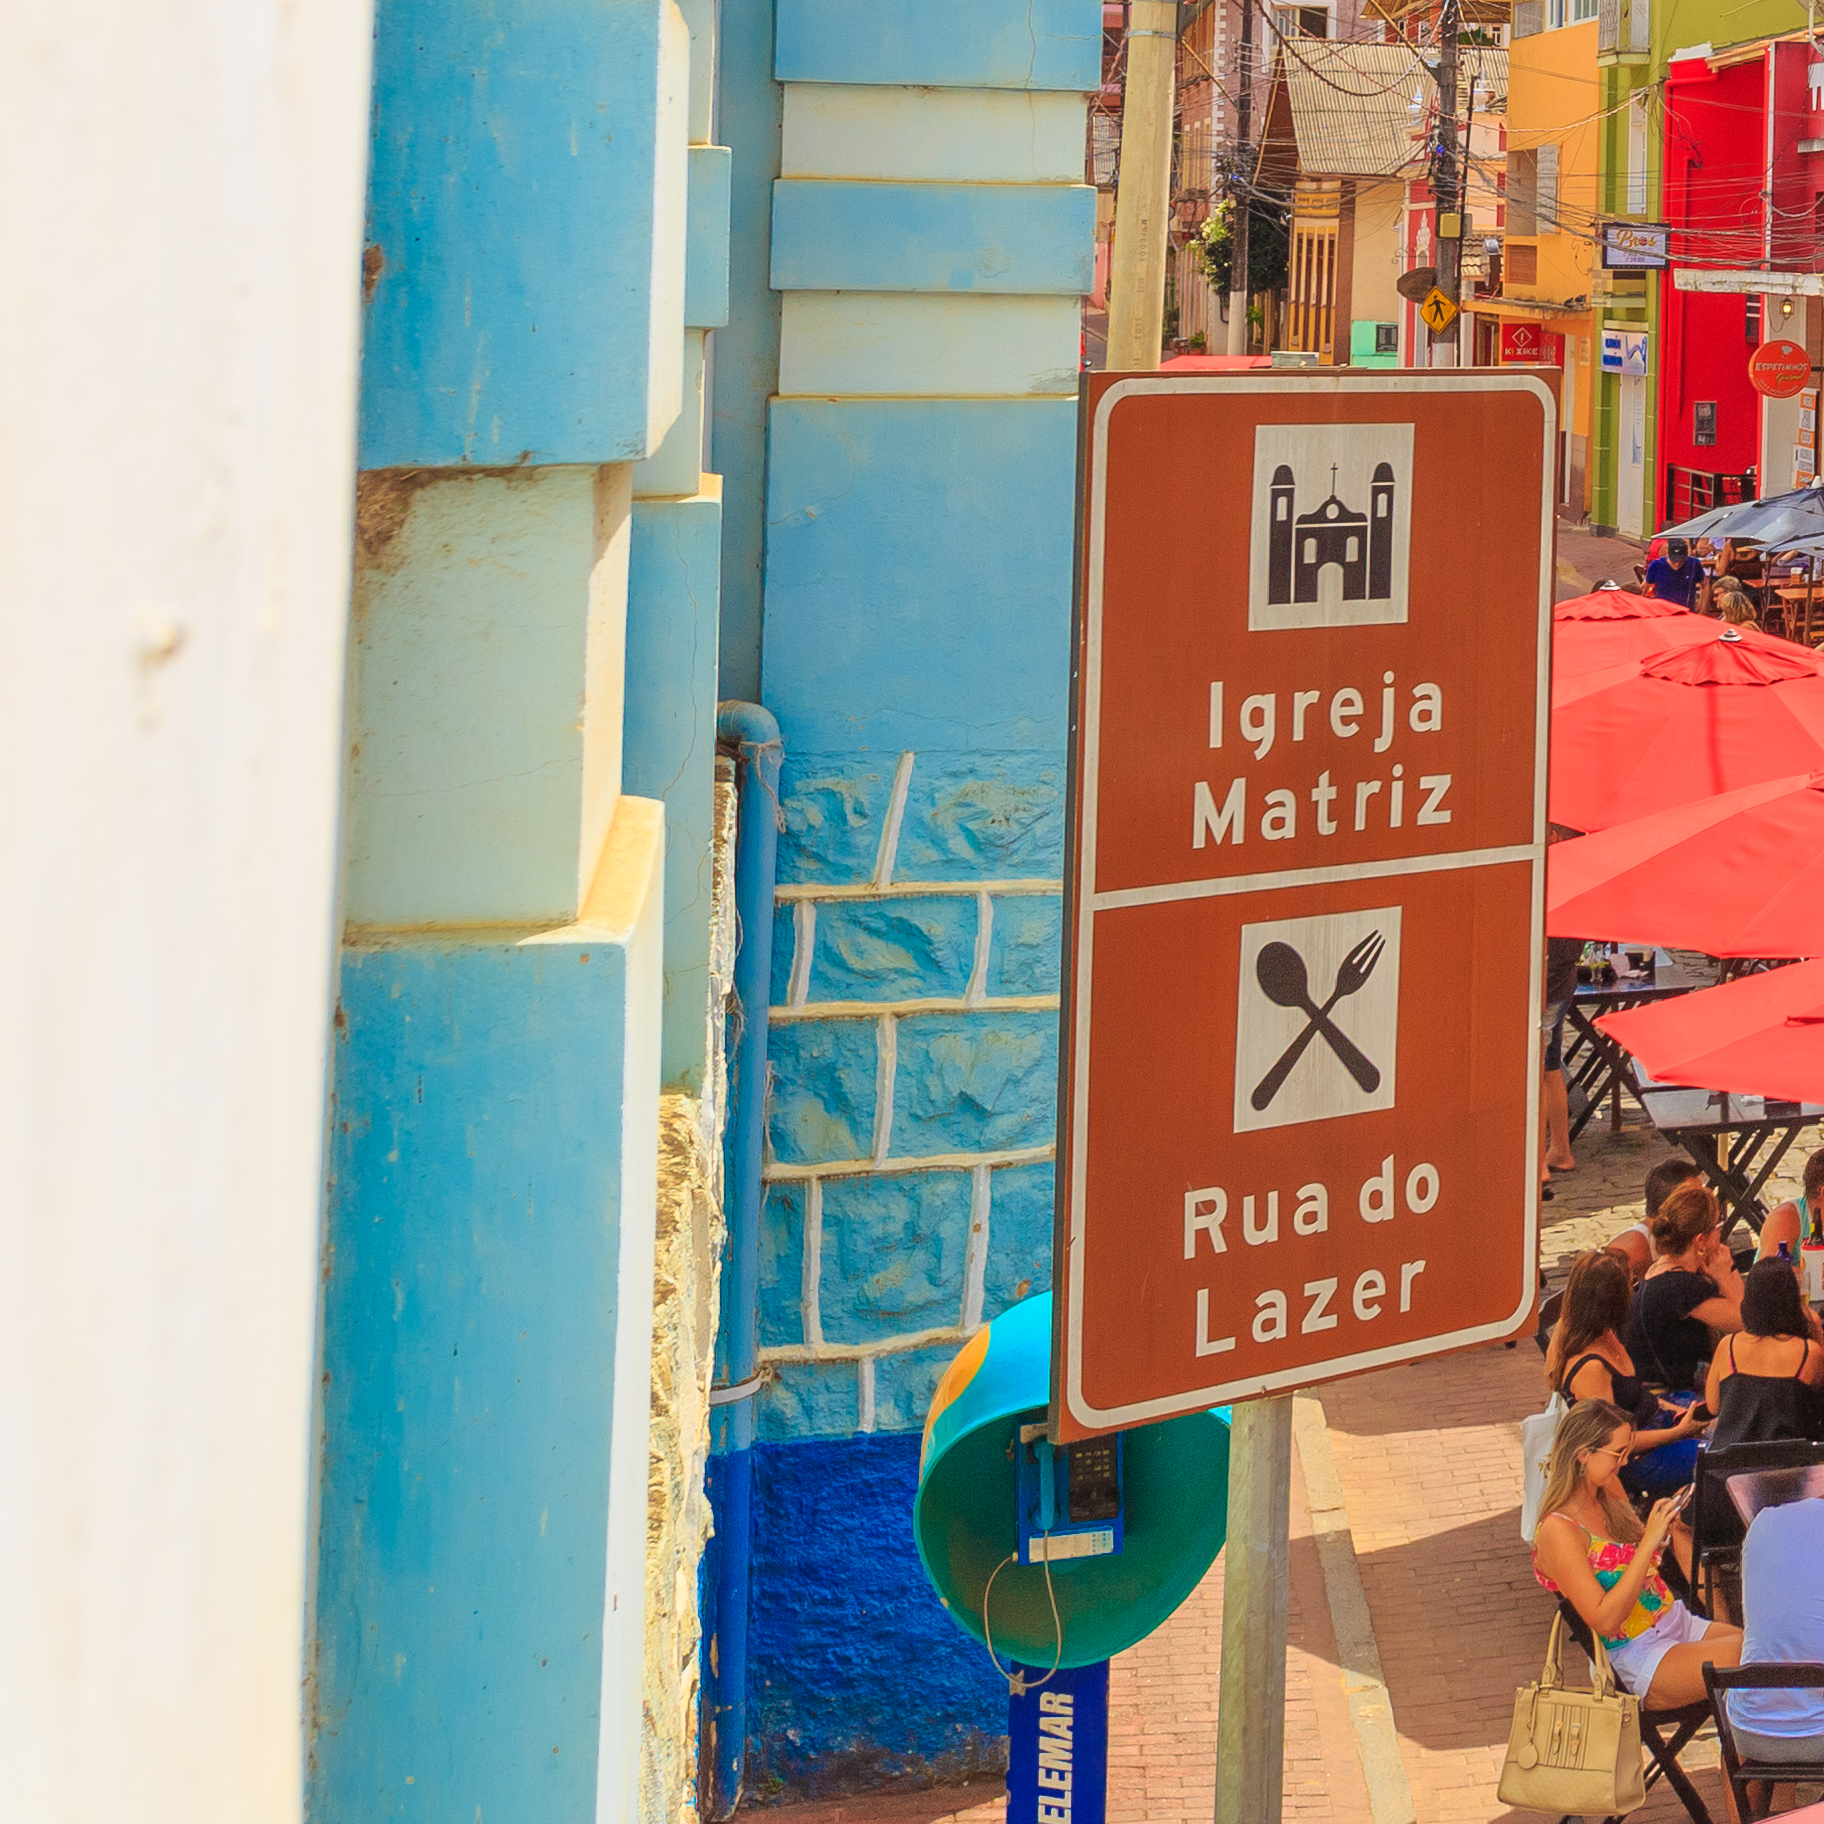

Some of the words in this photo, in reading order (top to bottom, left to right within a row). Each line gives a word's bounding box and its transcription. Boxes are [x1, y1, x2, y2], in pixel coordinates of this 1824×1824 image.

[1207, 670, 1445, 761] Igreja
[1191, 764, 1453, 851] Matriz
[1182, 1182, 1332, 1261] Rua
[1359, 1154, 1443, 1224] do
[1195, 1258, 1427, 1358] Lazer
[1037, 1690, 1075, 1824] ELEMAR
